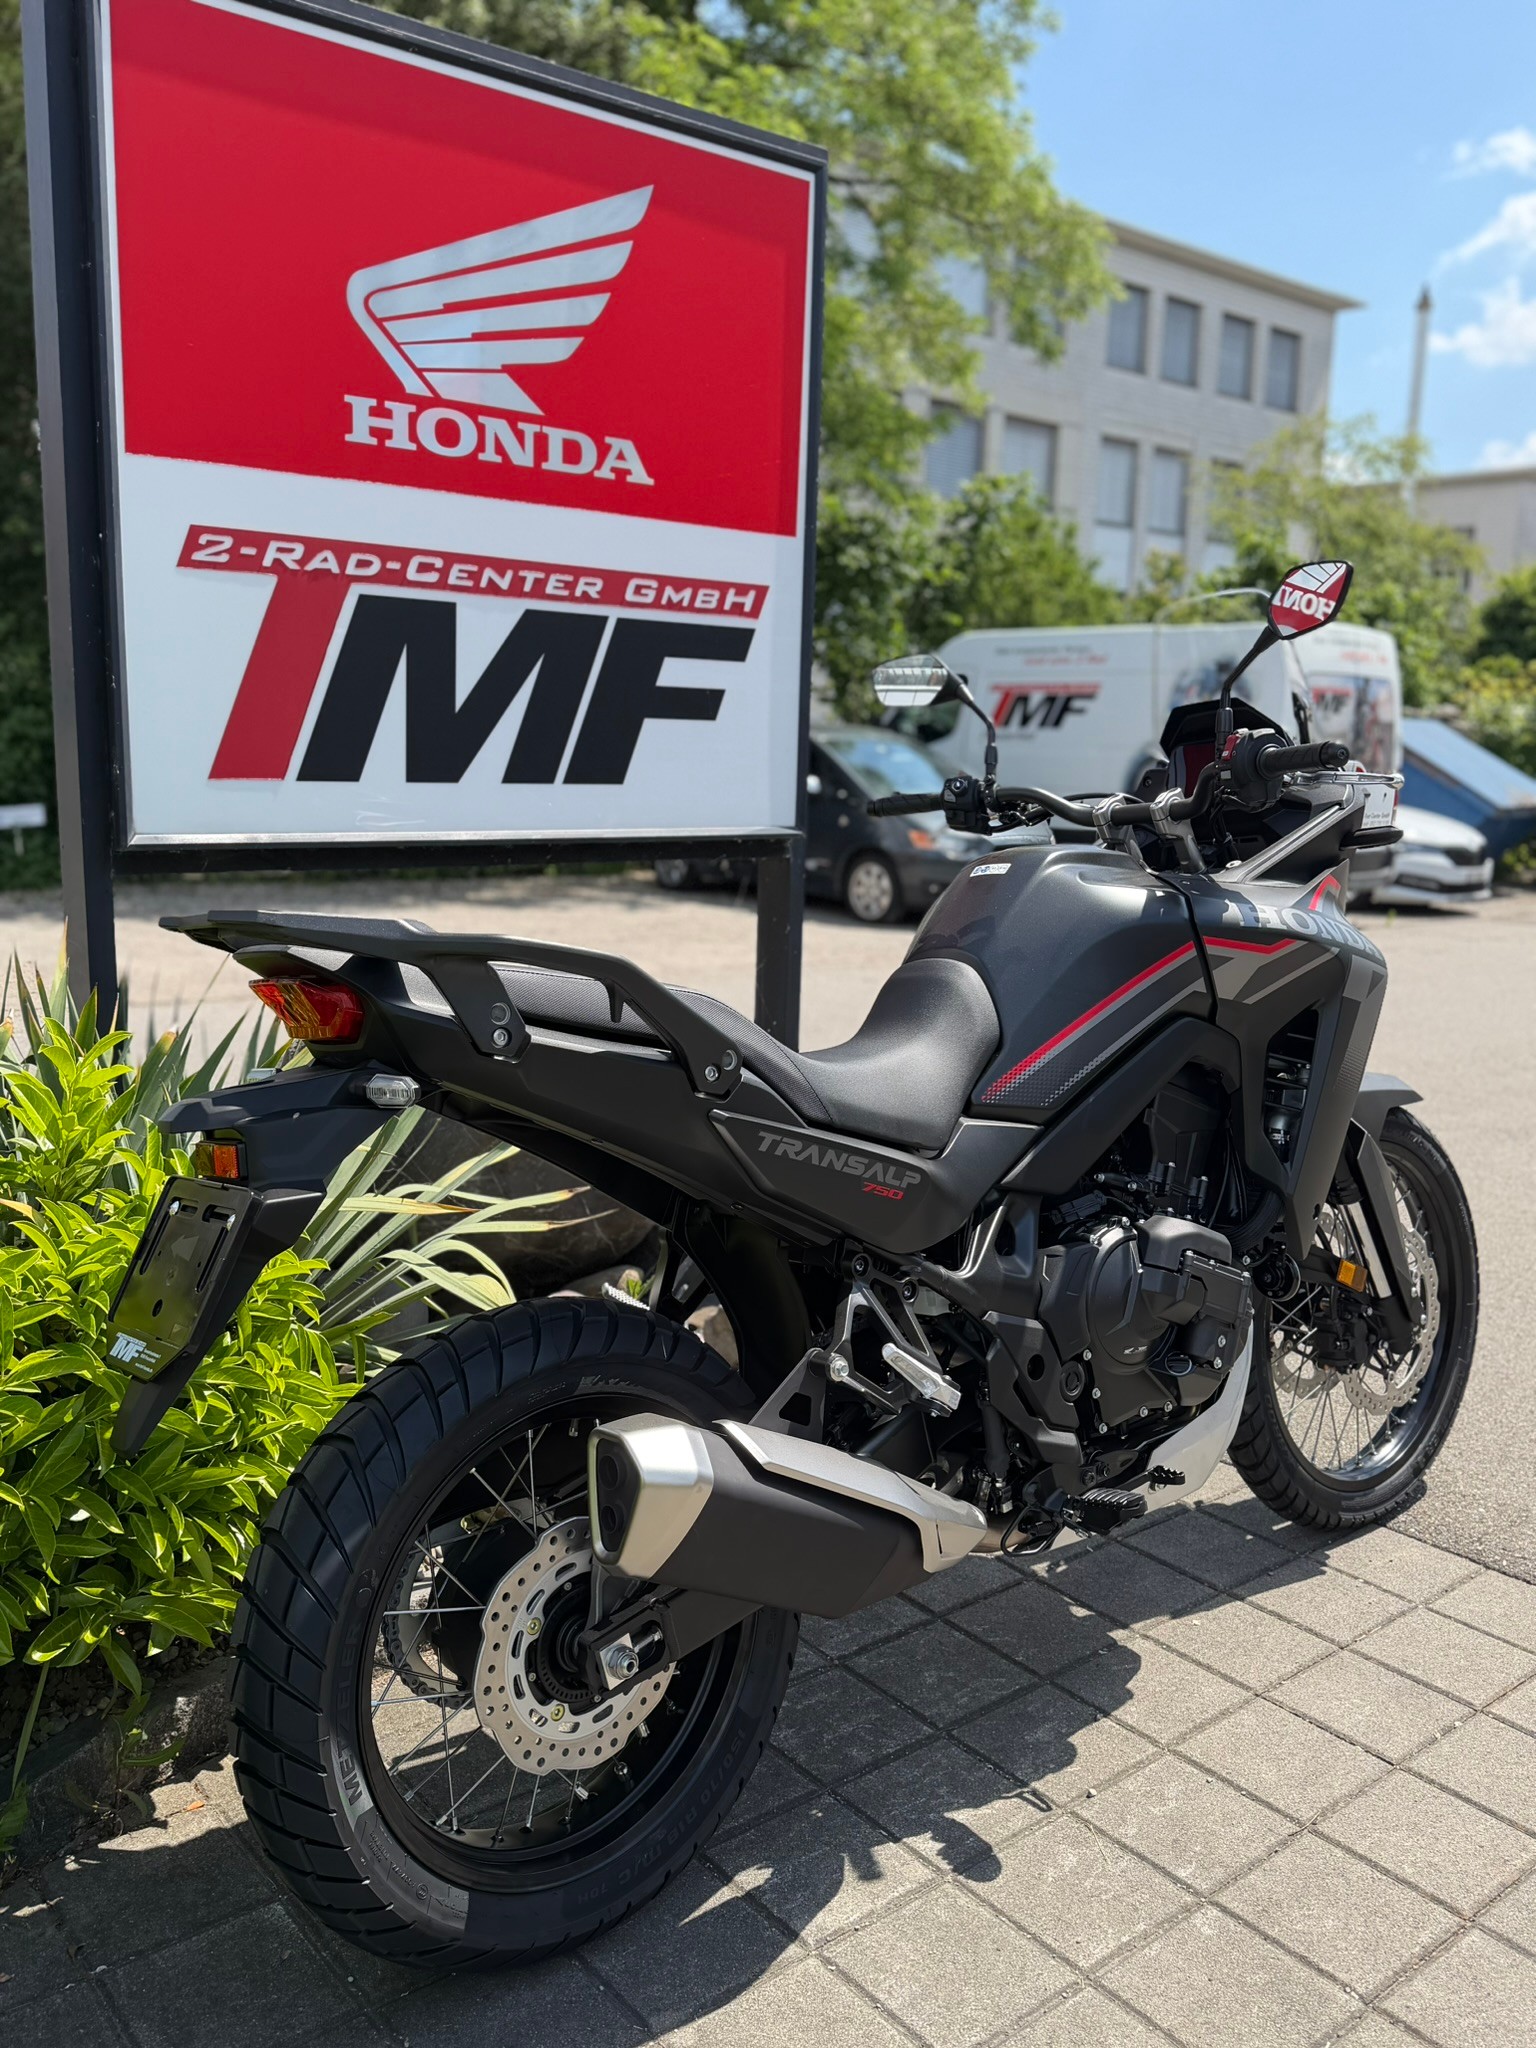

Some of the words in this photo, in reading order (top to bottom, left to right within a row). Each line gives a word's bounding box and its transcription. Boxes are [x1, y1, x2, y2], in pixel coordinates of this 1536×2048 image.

[344, 394, 655, 486] HONDA
[177, 524, 769, 785] TMF
[991, 683, 1101, 728] TMF
[758, 1131, 921, 1188] TRANSALP
[862, 1182, 904, 1200] 750
[109, 1332, 147, 1363] TMF
